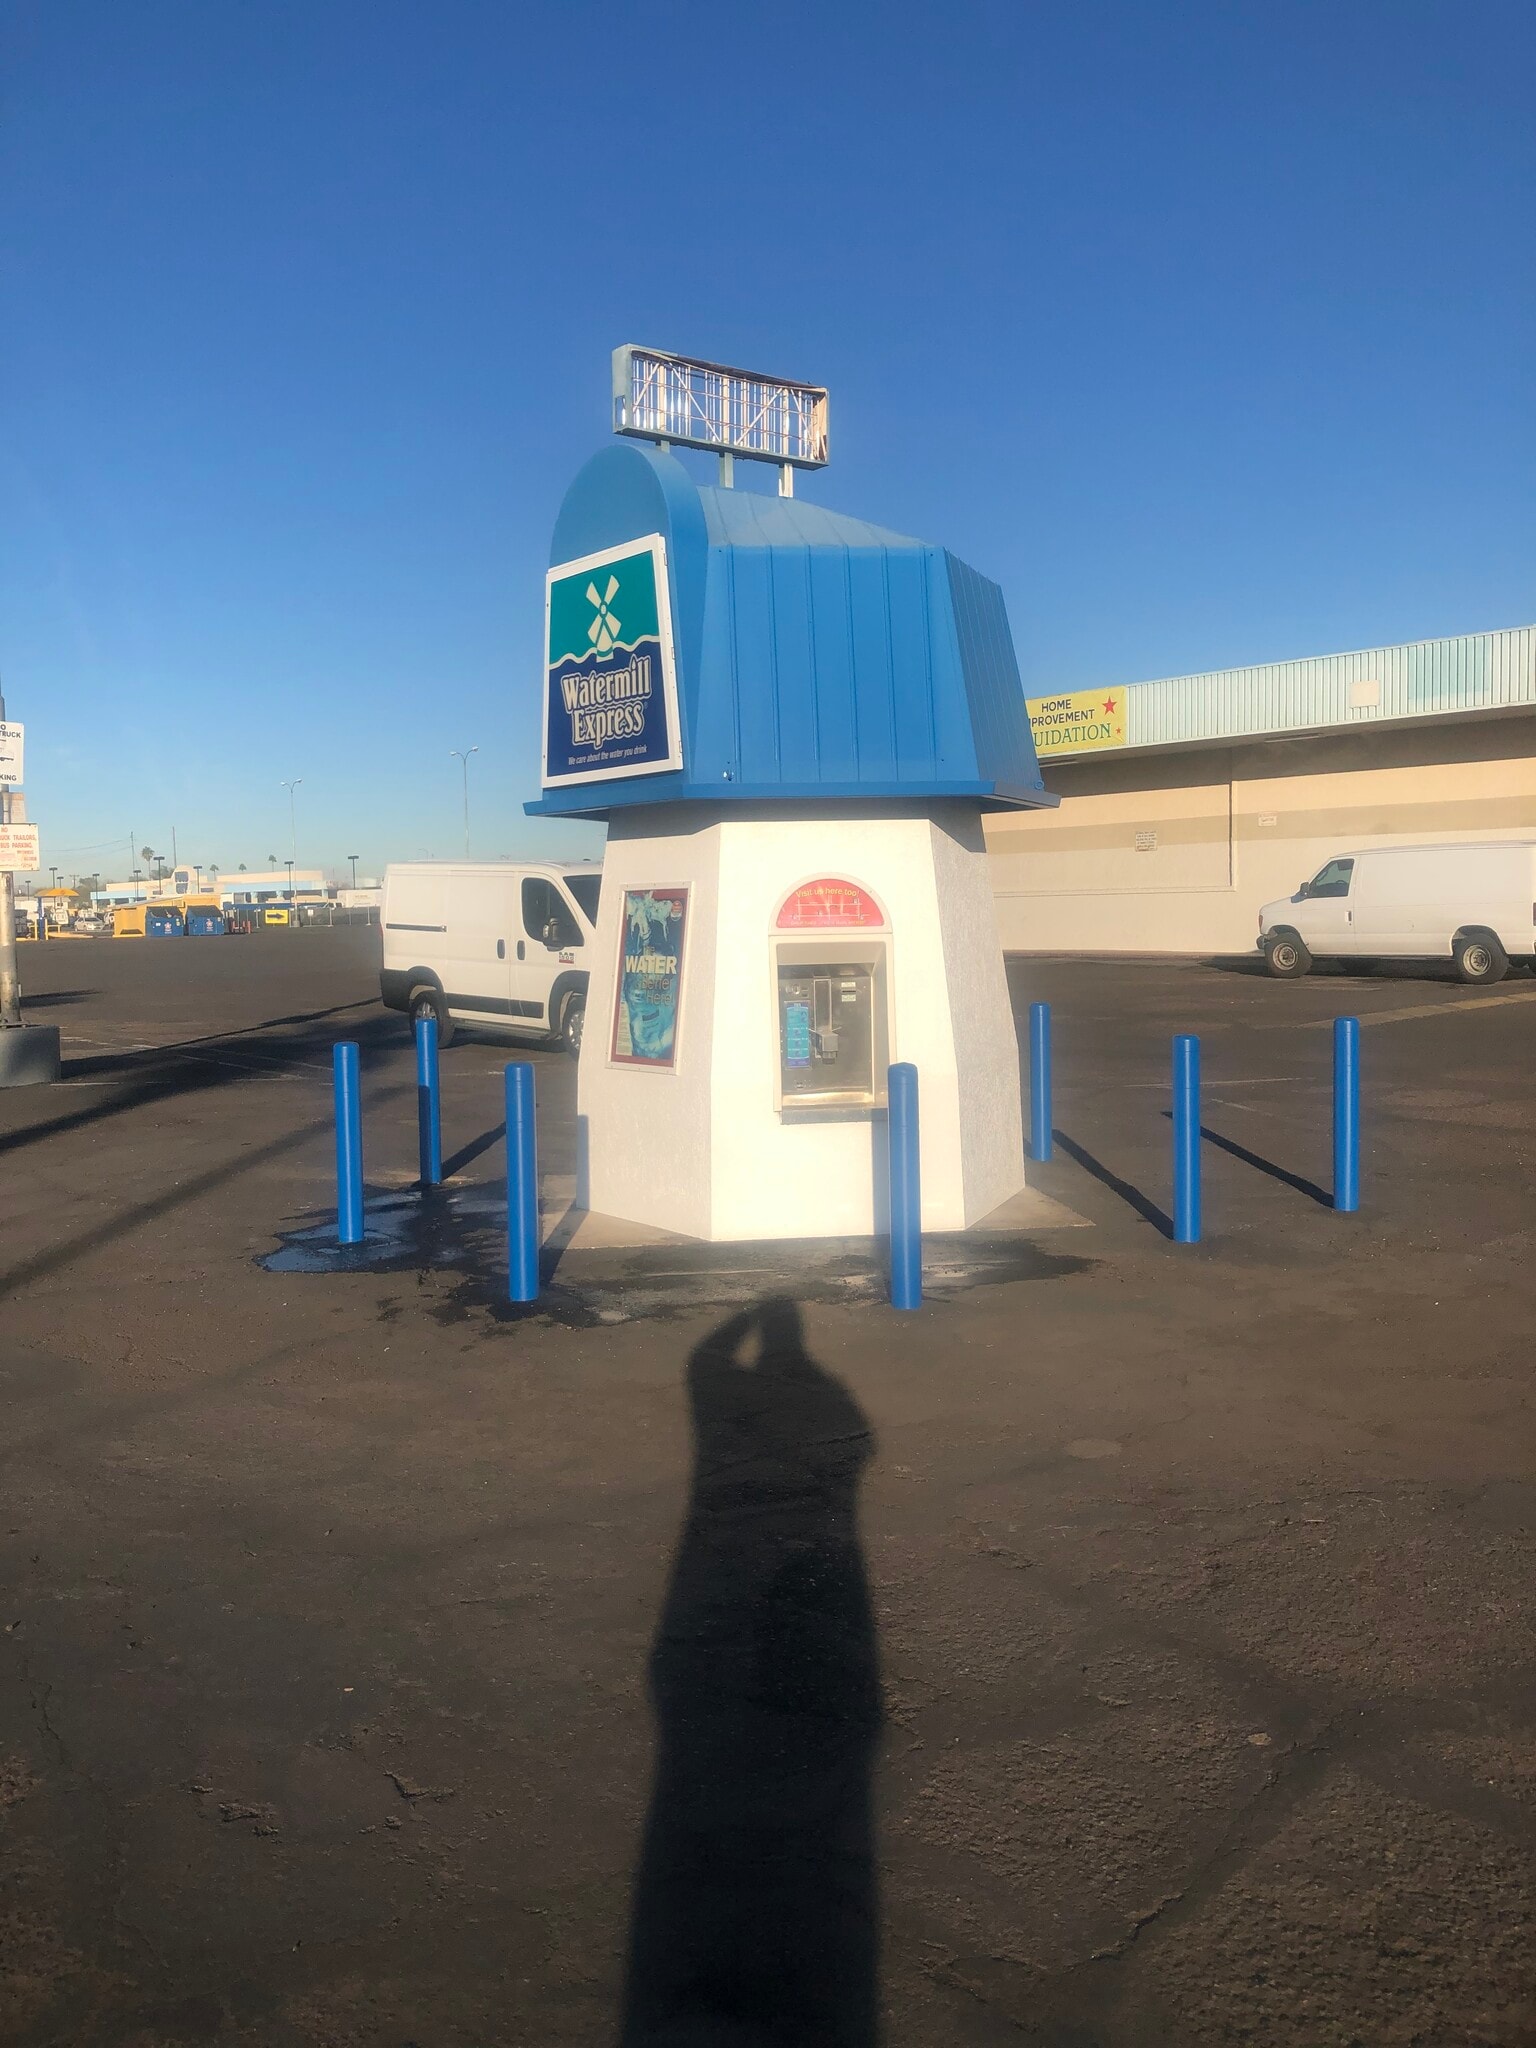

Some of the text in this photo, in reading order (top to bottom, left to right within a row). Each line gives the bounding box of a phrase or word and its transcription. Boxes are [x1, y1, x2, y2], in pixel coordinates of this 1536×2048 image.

[561, 656, 651, 711] Watermill
[1041, 699, 1072, 713] HOME
[572, 703, 644, 747] Express
[1029, 709, 1095, 727] PROVEMENT
[576, 756, 587, 764] care
[587, 753, 601, 763] about
[601, 751, 609, 760] the
[609, 749, 624, 758] water
[624, 748, 634, 758] you
[634, 744, 648, 755] drink
[825, 887, 843, 895] here
[625, 954, 677, 975] WATER
